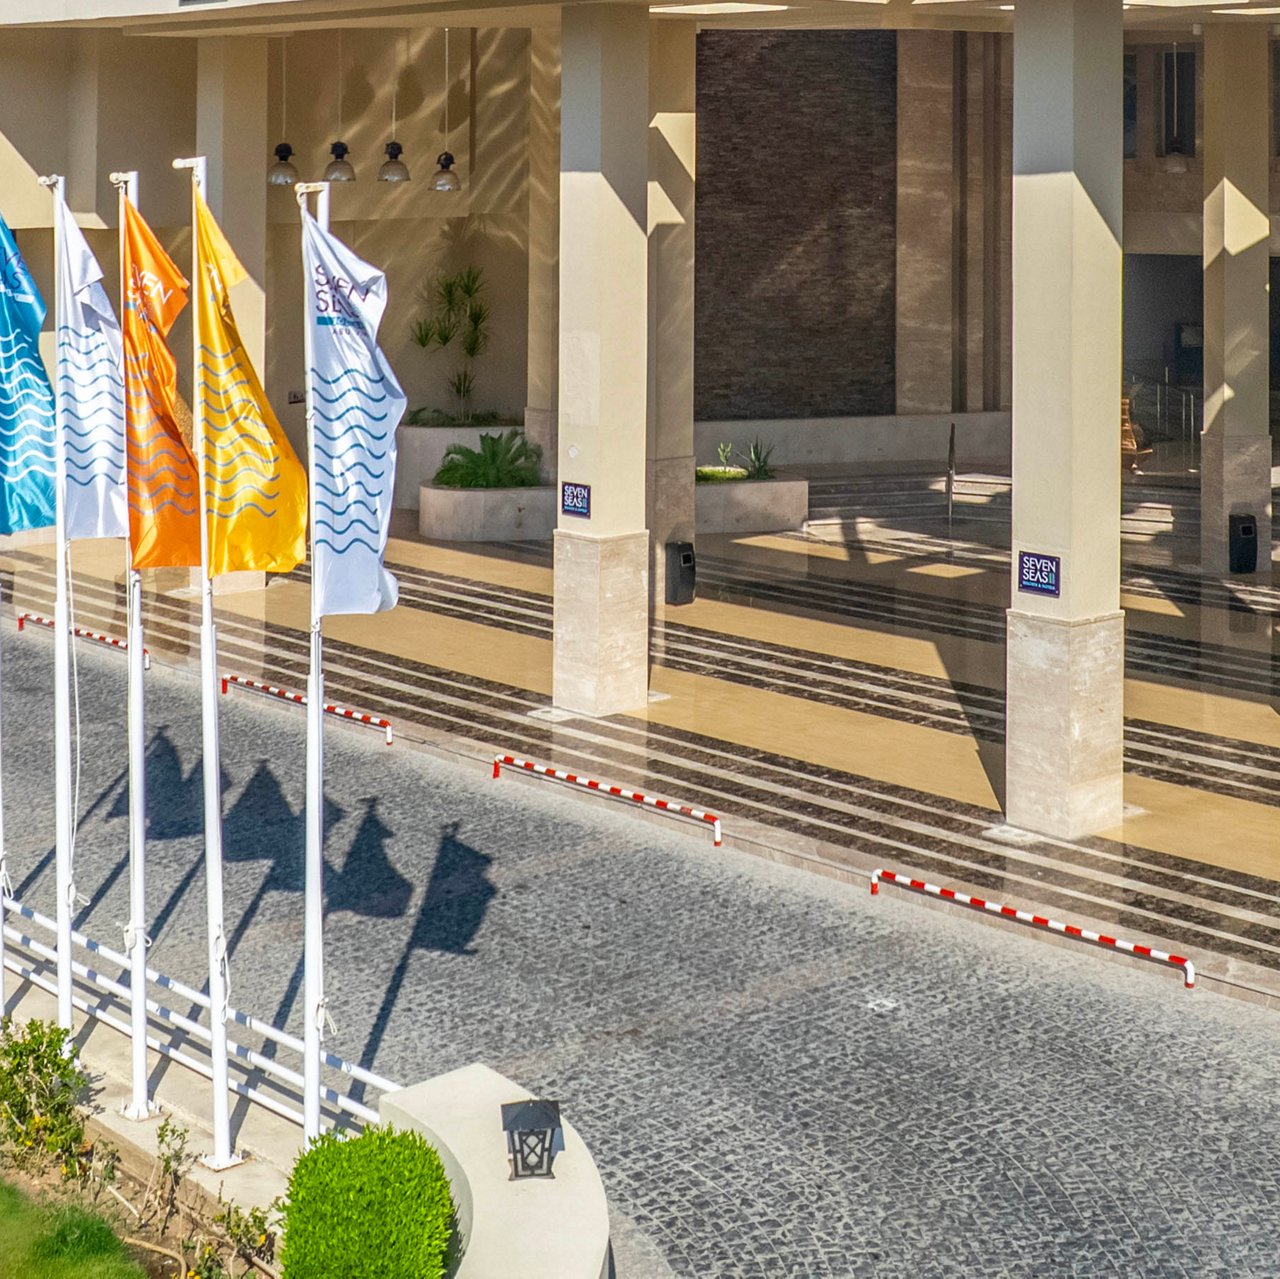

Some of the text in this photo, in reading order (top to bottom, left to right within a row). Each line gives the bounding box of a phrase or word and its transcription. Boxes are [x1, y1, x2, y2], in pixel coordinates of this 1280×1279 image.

[564, 485, 587, 498] SEVEN
[564, 495, 582, 507] SEAS
[1023, 556, 1055, 573] SEVEN
[1023, 569, 1048, 583] SEAS
